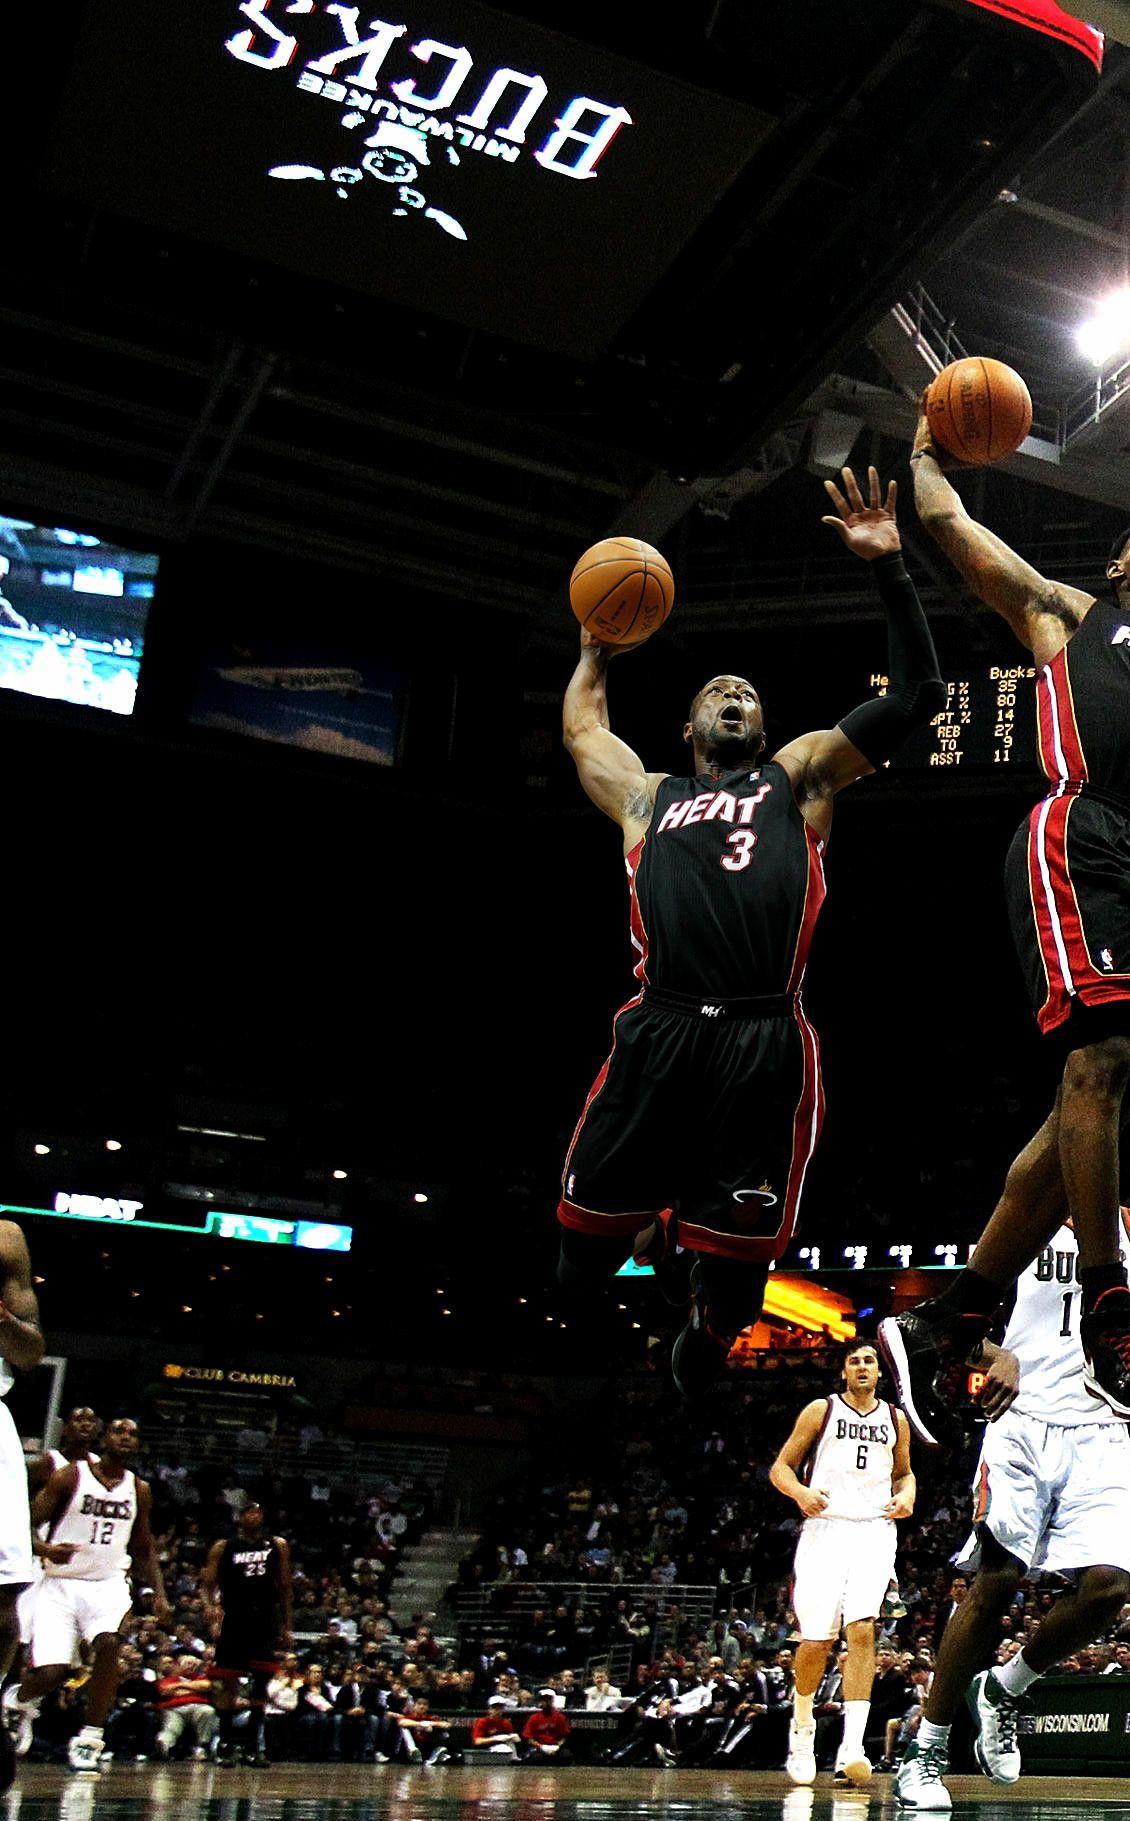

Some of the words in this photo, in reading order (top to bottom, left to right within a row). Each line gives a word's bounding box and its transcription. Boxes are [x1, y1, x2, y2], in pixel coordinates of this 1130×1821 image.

[225, 0, 632, 179] BUCKS
[296, 70, 520, 163] MILWAUKEE
[870, 674, 889, 687] He
[990, 666, 1035, 680] Bucks
[998, 680, 1016, 692] 35
[997, 694, 1015, 707] 80
[997, 711, 1014, 722] 14
[938, 725, 960, 738] REB
[994, 724, 1013, 737] 27
[940, 739, 956, 751] TO
[1003, 736, 1012, 749] 9
[930, 751, 963, 766] ASST
[994, 750, 1010, 763] 11
[656, 783, 773, 835] HEAT
[720, 828, 758, 872] 3
[184, 1367, 223, 1381] CLUB
[228, 1370, 297, 1387] CAMBRIA
[835, 1418, 888, 1445] BUCKS
[856, 1445, 868, 1470] 6
[80, 1494, 131, 1520] BUCKS
[89, 1521, 113, 1545] 12
[244, 1563, 267, 1577] 25
